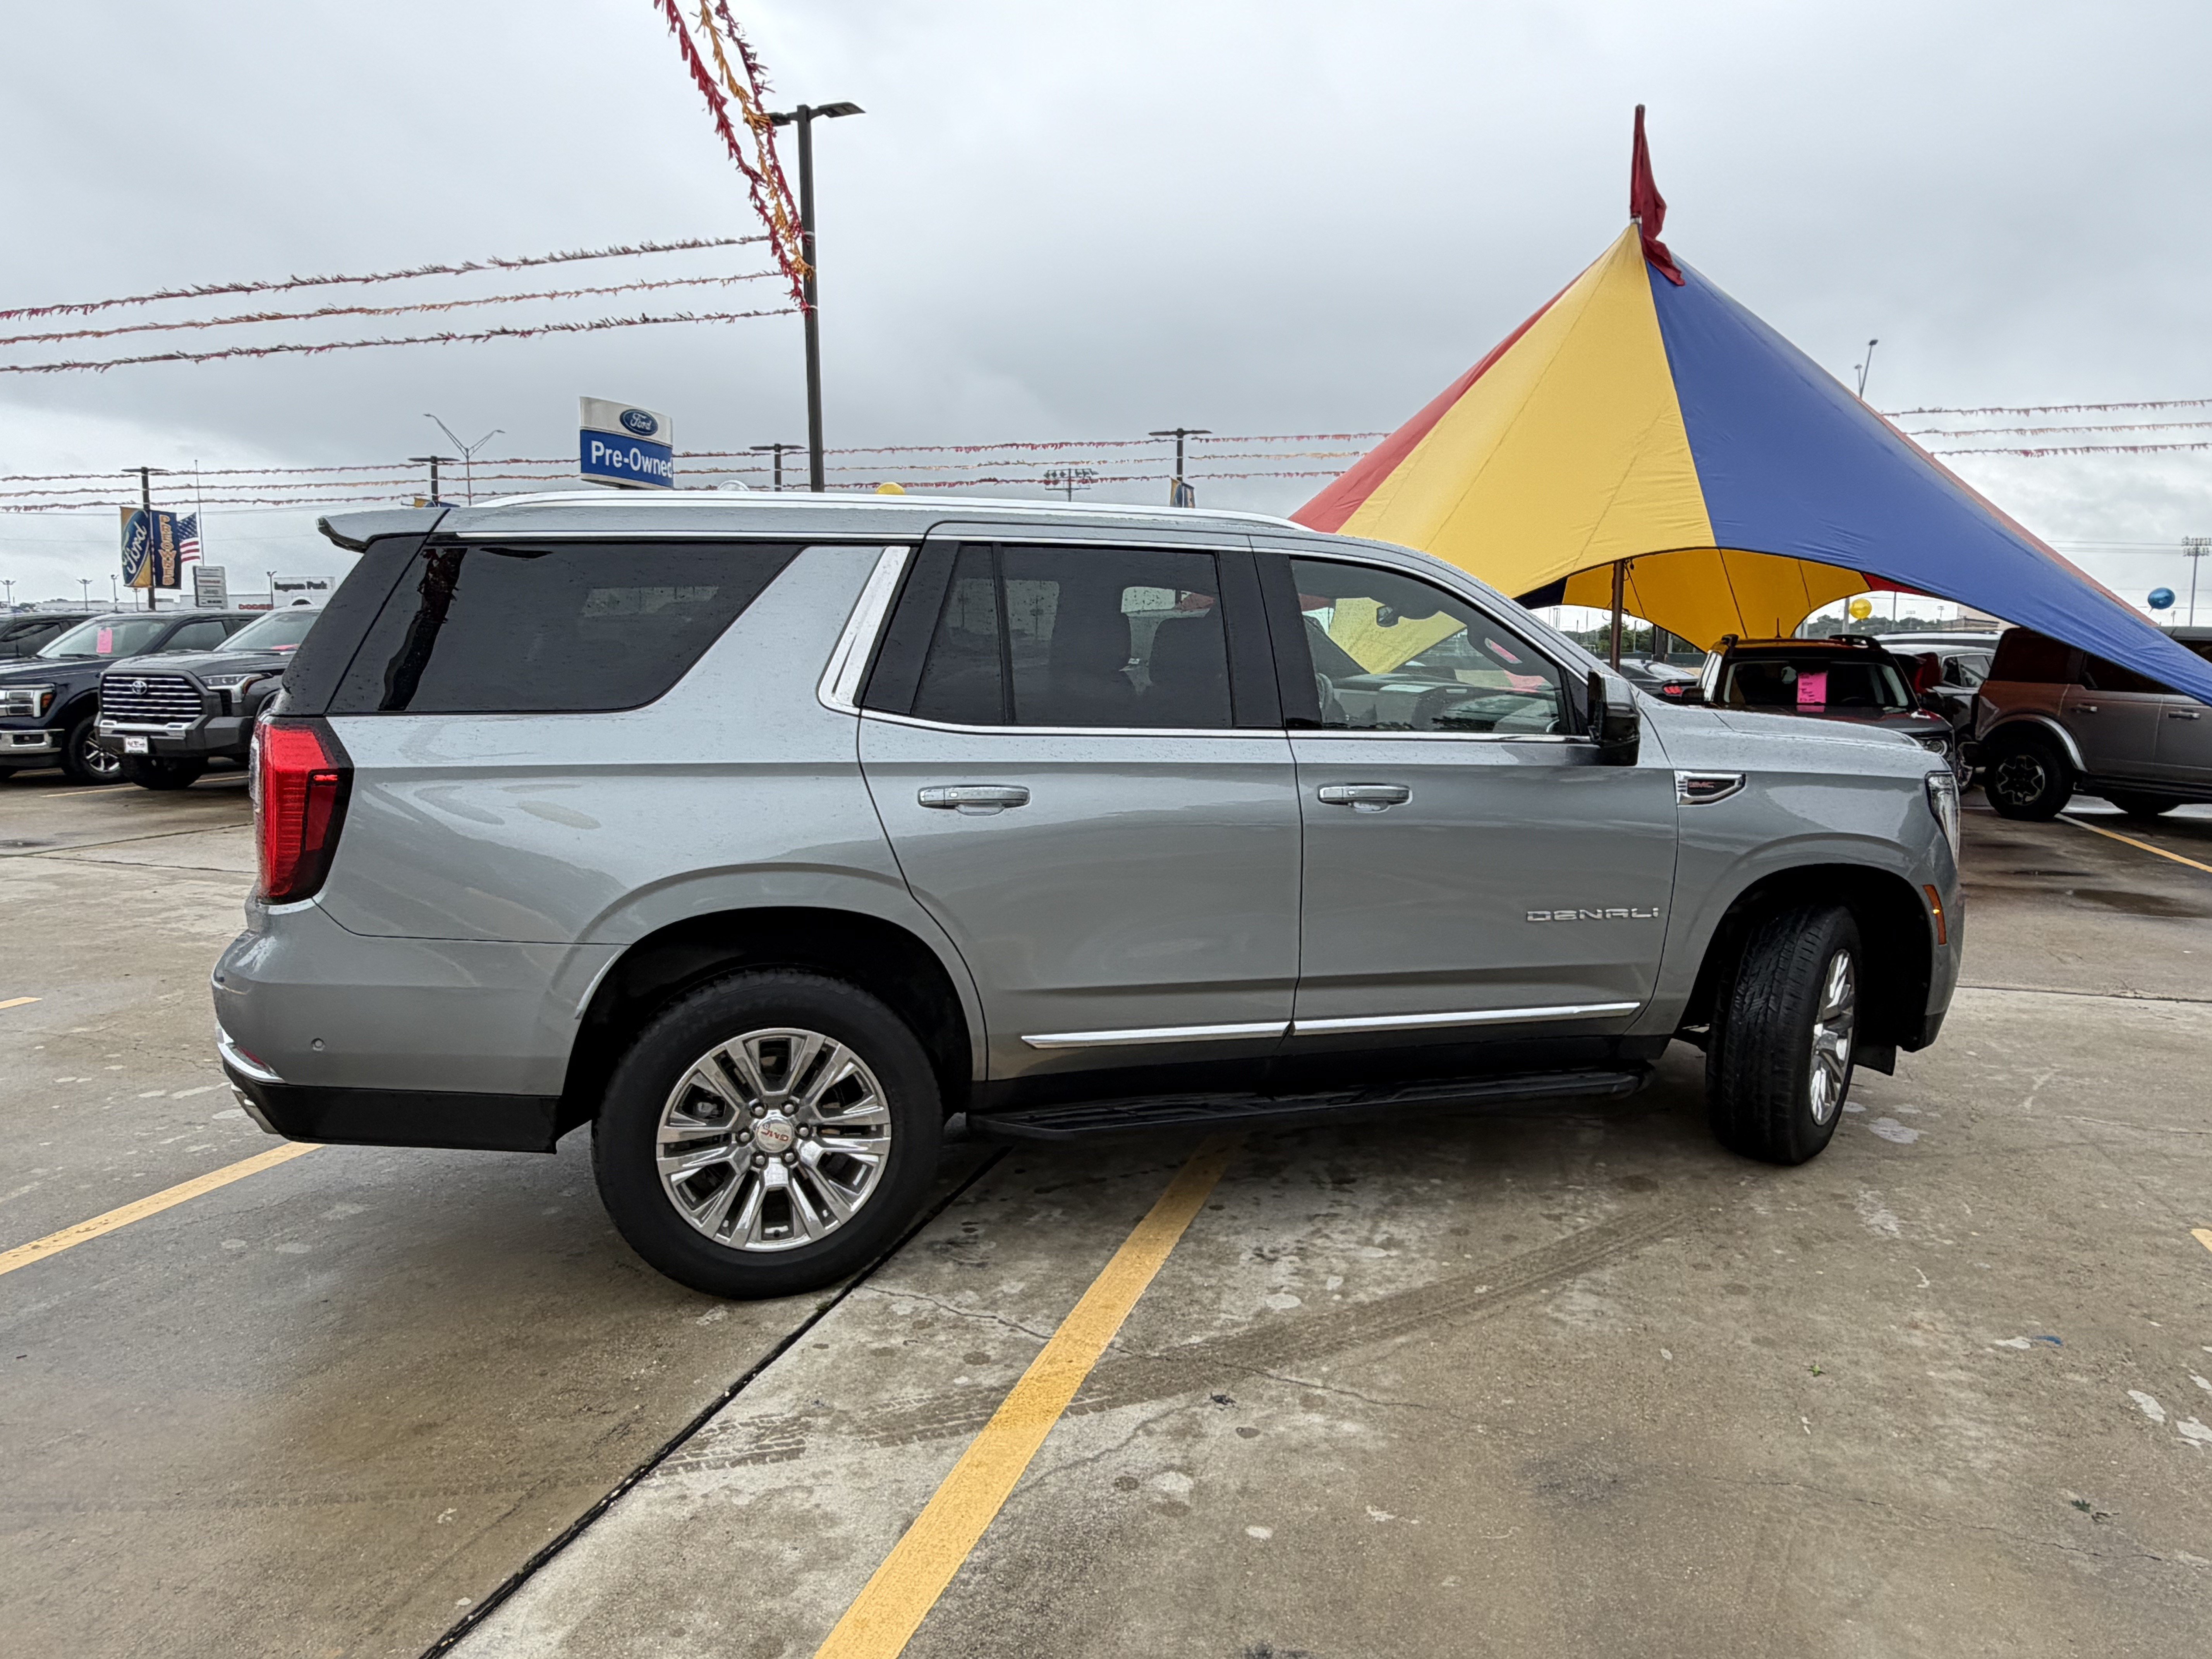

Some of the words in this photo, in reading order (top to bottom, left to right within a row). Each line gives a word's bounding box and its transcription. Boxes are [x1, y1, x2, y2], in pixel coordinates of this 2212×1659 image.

[630, 412, 653, 430] Ford
[122, 521, 148, 574] Ford
[1527, 907, 1659, 921] DENALI
